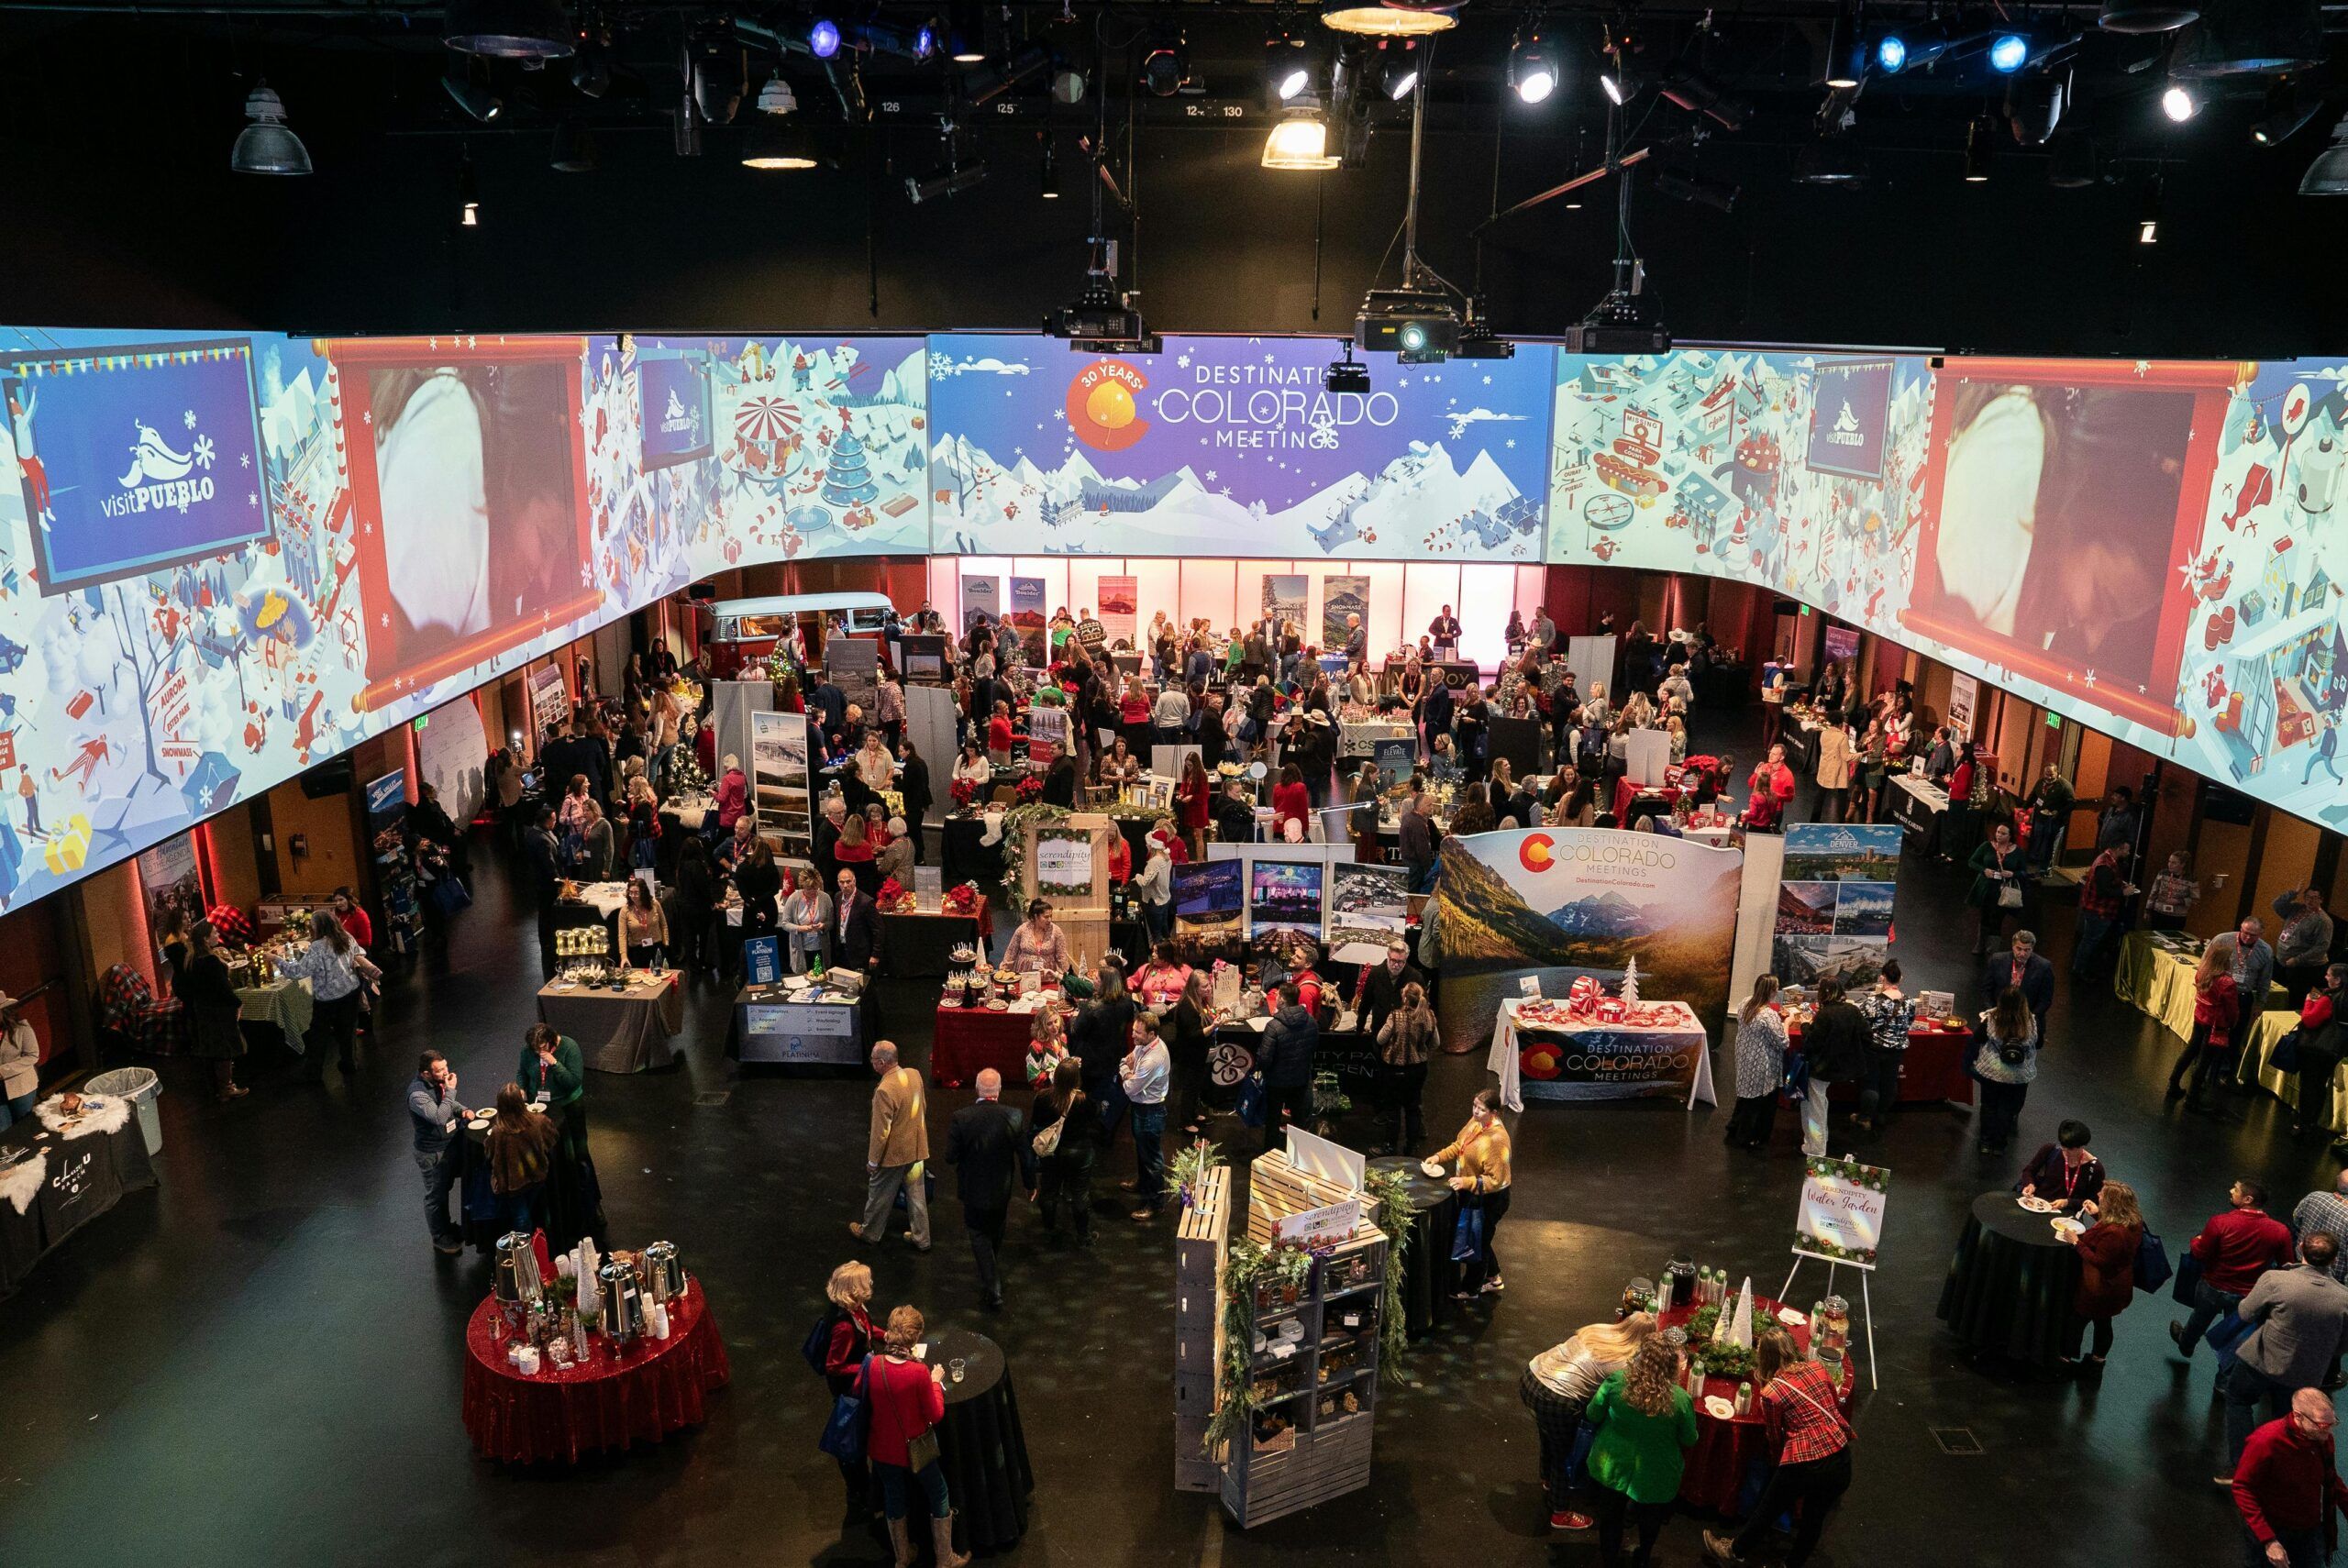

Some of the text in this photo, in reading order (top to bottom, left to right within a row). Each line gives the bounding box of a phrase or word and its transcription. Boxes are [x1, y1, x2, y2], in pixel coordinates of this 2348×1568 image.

[882, 102, 900, 112] 126
[1224, 106, 1243, 117] 130
[1081, 365, 1140, 390] 30 YEARS
[1196, 365, 1323, 385] DESTINATI
[1157, 388, 1400, 426] COLORADO
[1626, 414, 1657, 429] MISSING
[1216, 430, 1340, 450] MEETINGS
[1623, 449, 1646, 461] COUNTY
[1628, 445, 1643, 455] PARK
[1564, 469, 1582, 478] OURAY
[1565, 482, 1584, 492] PUEBLO
[100, 476, 215, 518] visitPUEBLO
[161, 675, 187, 710] AURORA
[167, 702, 191, 732] ESTES PARK
[2048, 712, 2060, 728] EXIT
[161, 747, 193, 757] SNOWMASS
[1578, 834, 1660, 849] DESTINATION
[1830, 840, 1859, 848] DENVER
[1039, 849, 1091, 864] serendipity
[1559, 845, 1676, 869] COLORADO
[1586, 865, 1647, 878] MEETINGS
[1576, 877, 1656, 889] DestinationColorado.com
[1587, 1044, 1674, 1055] DESTINATION
[1567, 1055, 1689, 1071] COLORADO
[1594, 1071, 1658, 1081] MEETINGS
[83, 1153, 91, 1165] U
[1822, 1185, 1867, 1198] SERENDIPITY
[1807, 1188, 1877, 1214] Water Garden
[1303, 1203, 1355, 1222] serendipity
